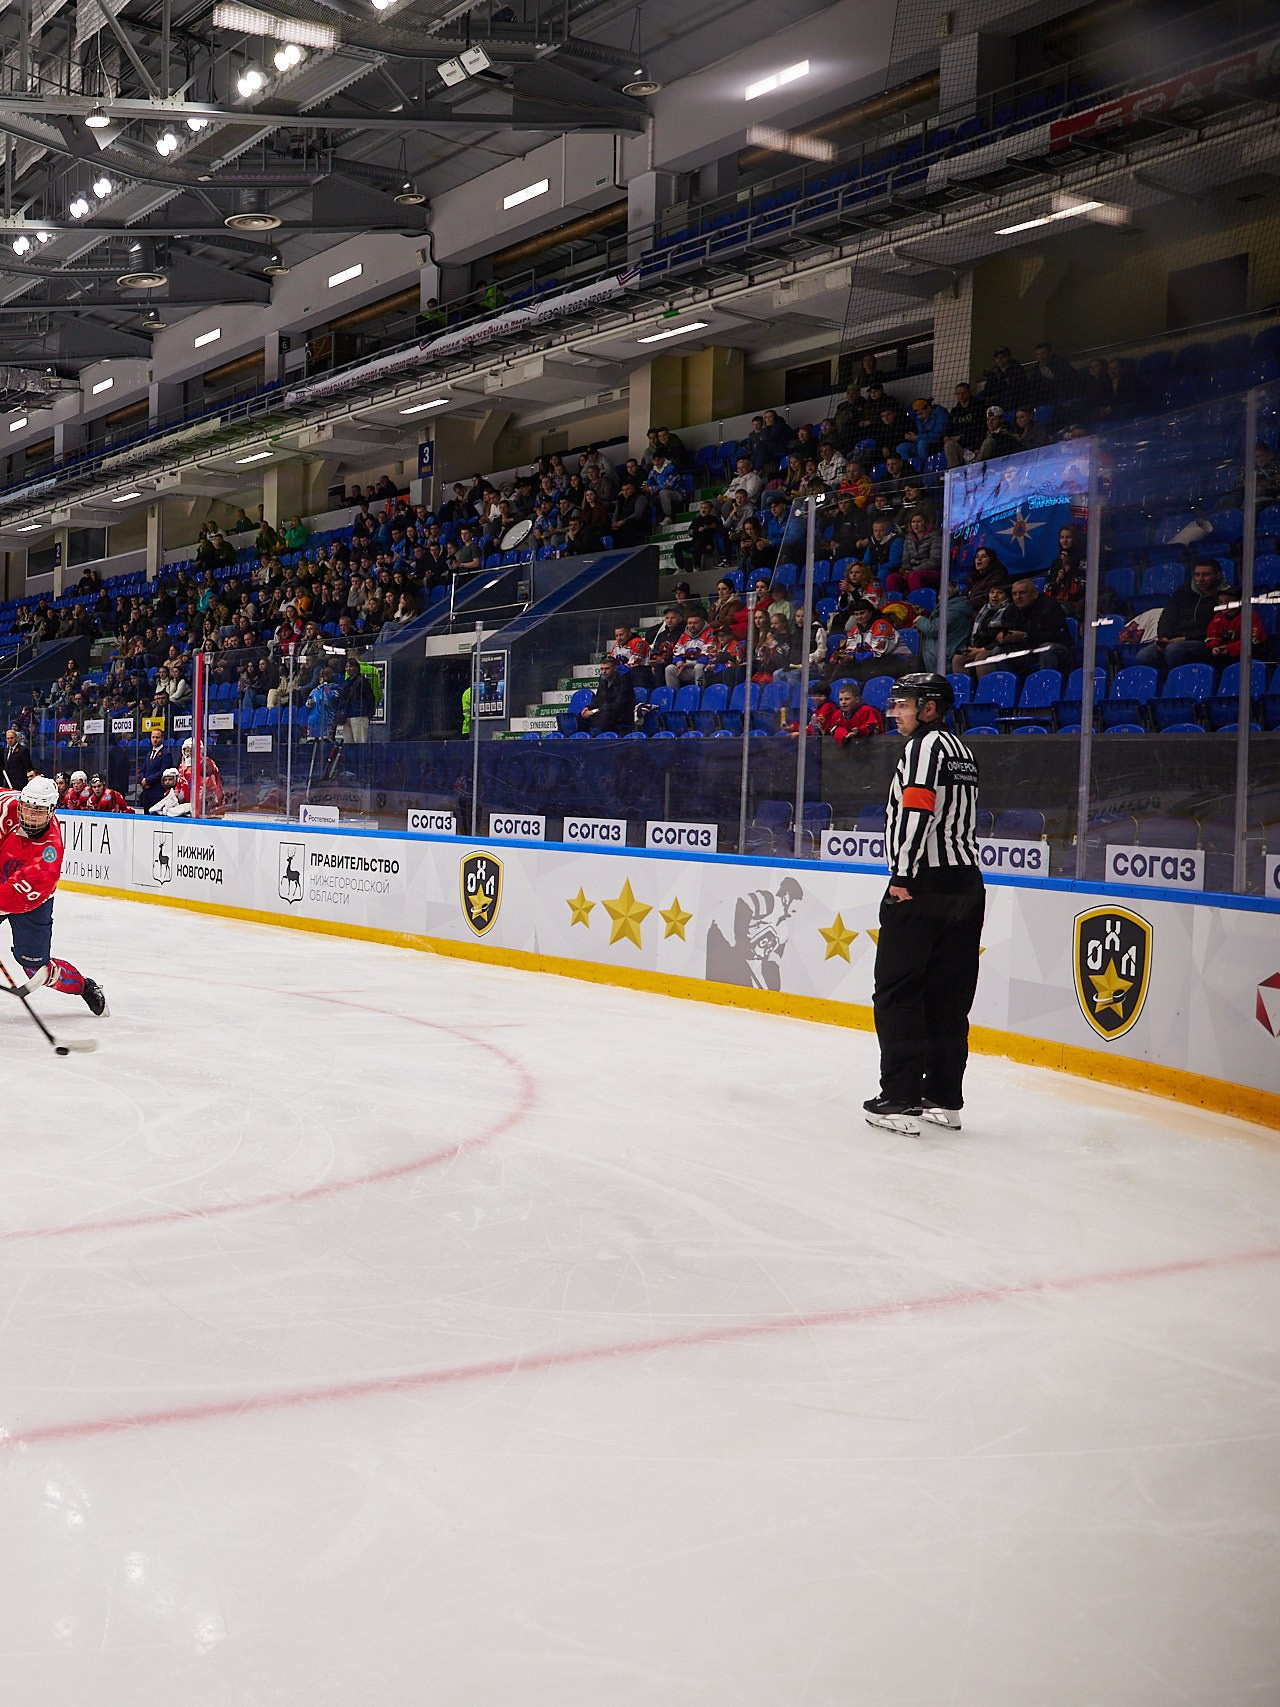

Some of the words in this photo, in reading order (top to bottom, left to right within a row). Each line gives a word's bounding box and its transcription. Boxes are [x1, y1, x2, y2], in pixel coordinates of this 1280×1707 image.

[282, 341, 288, 349] 6
[423, 446, 430, 463] 3
[175, 718, 193, 728] KHL.R
[308, 814, 336, 823] Ростелеком
[176, 845, 215, 863] НИЖНИЙ
[59, 860, 110, 881] ИЛЬНЫХ
[310, 852, 400, 875] ПРАВИТЕЛЬСТВО
[176, 863, 223, 884] НОВГОРОД
[309, 874, 391, 894] НИЖЕГОРОДСКОЙ
[309, 889, 350, 905] ОБЛАСТИ
